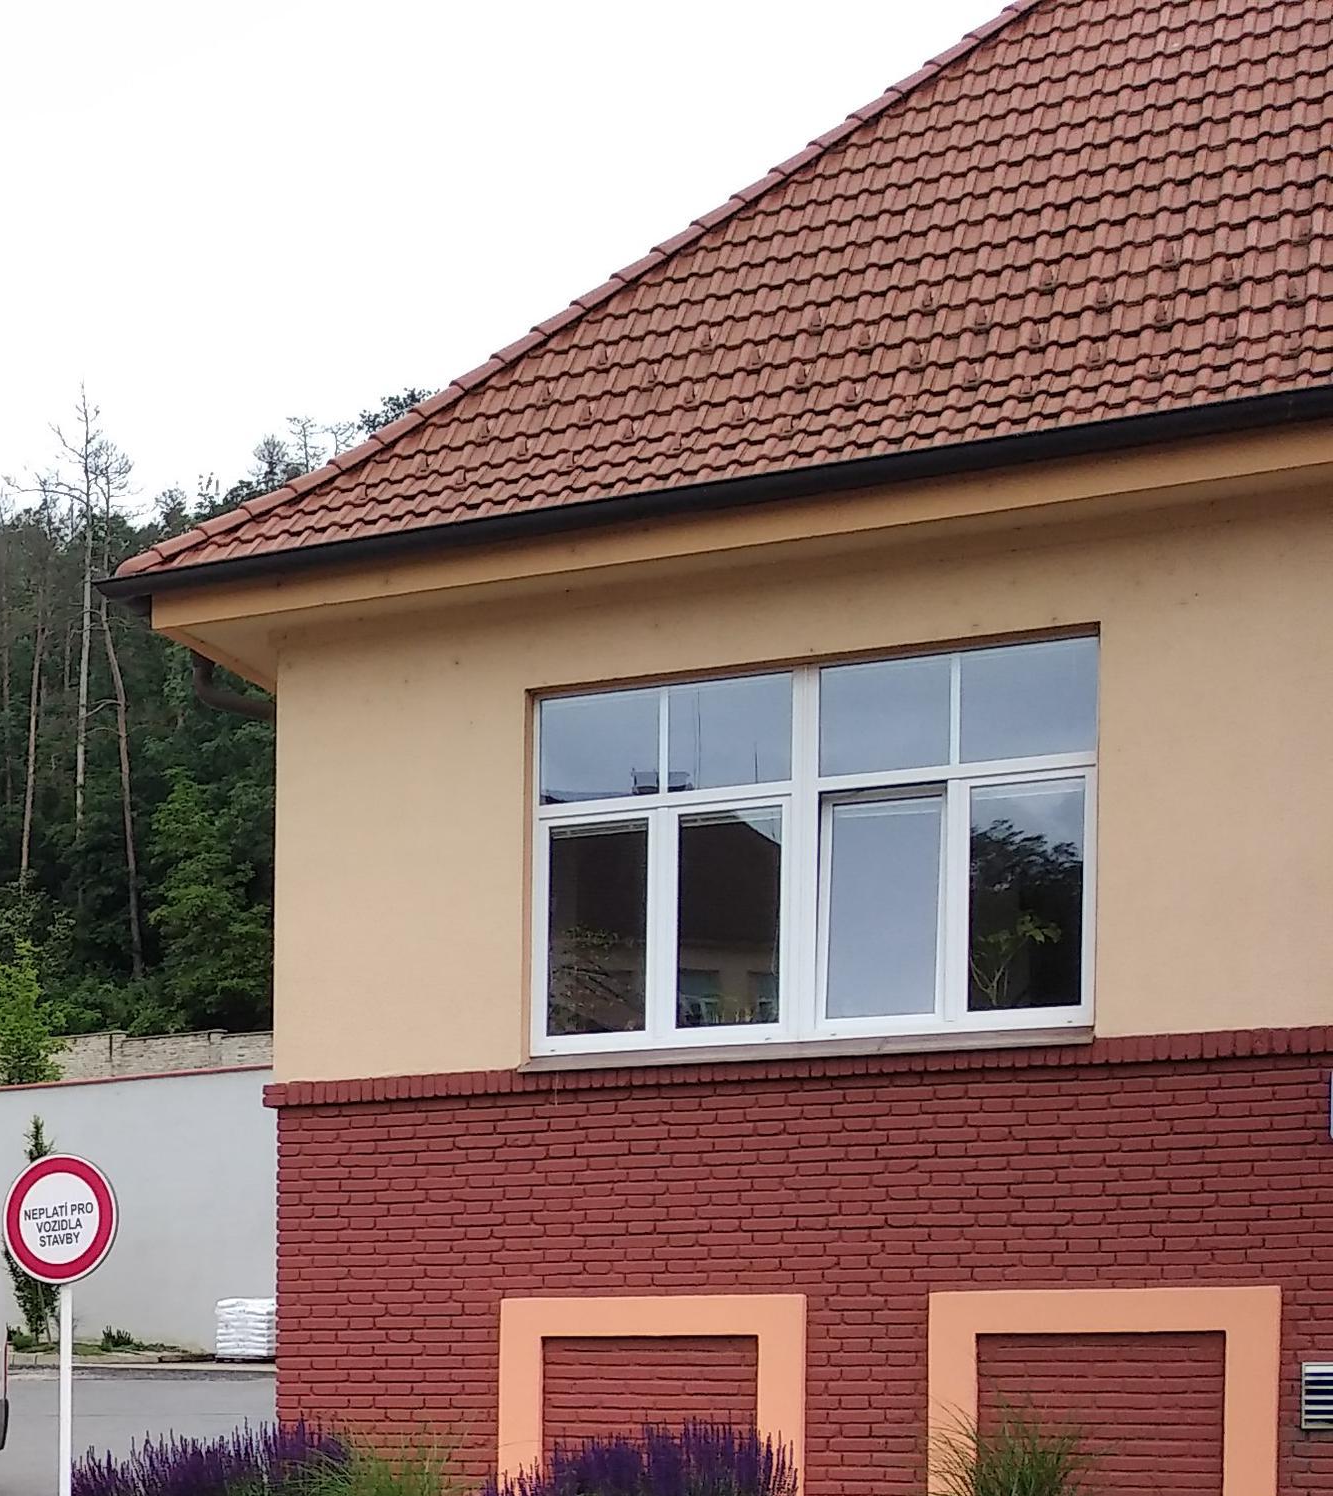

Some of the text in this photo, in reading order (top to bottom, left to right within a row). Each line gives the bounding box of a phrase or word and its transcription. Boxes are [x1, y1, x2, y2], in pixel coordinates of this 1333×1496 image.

[24, 1202, 94, 1221] NEPLATÍ PRO
[36, 1217, 83, 1233] VOZIDLA
[39, 1232, 80, 1248] STAVBY
